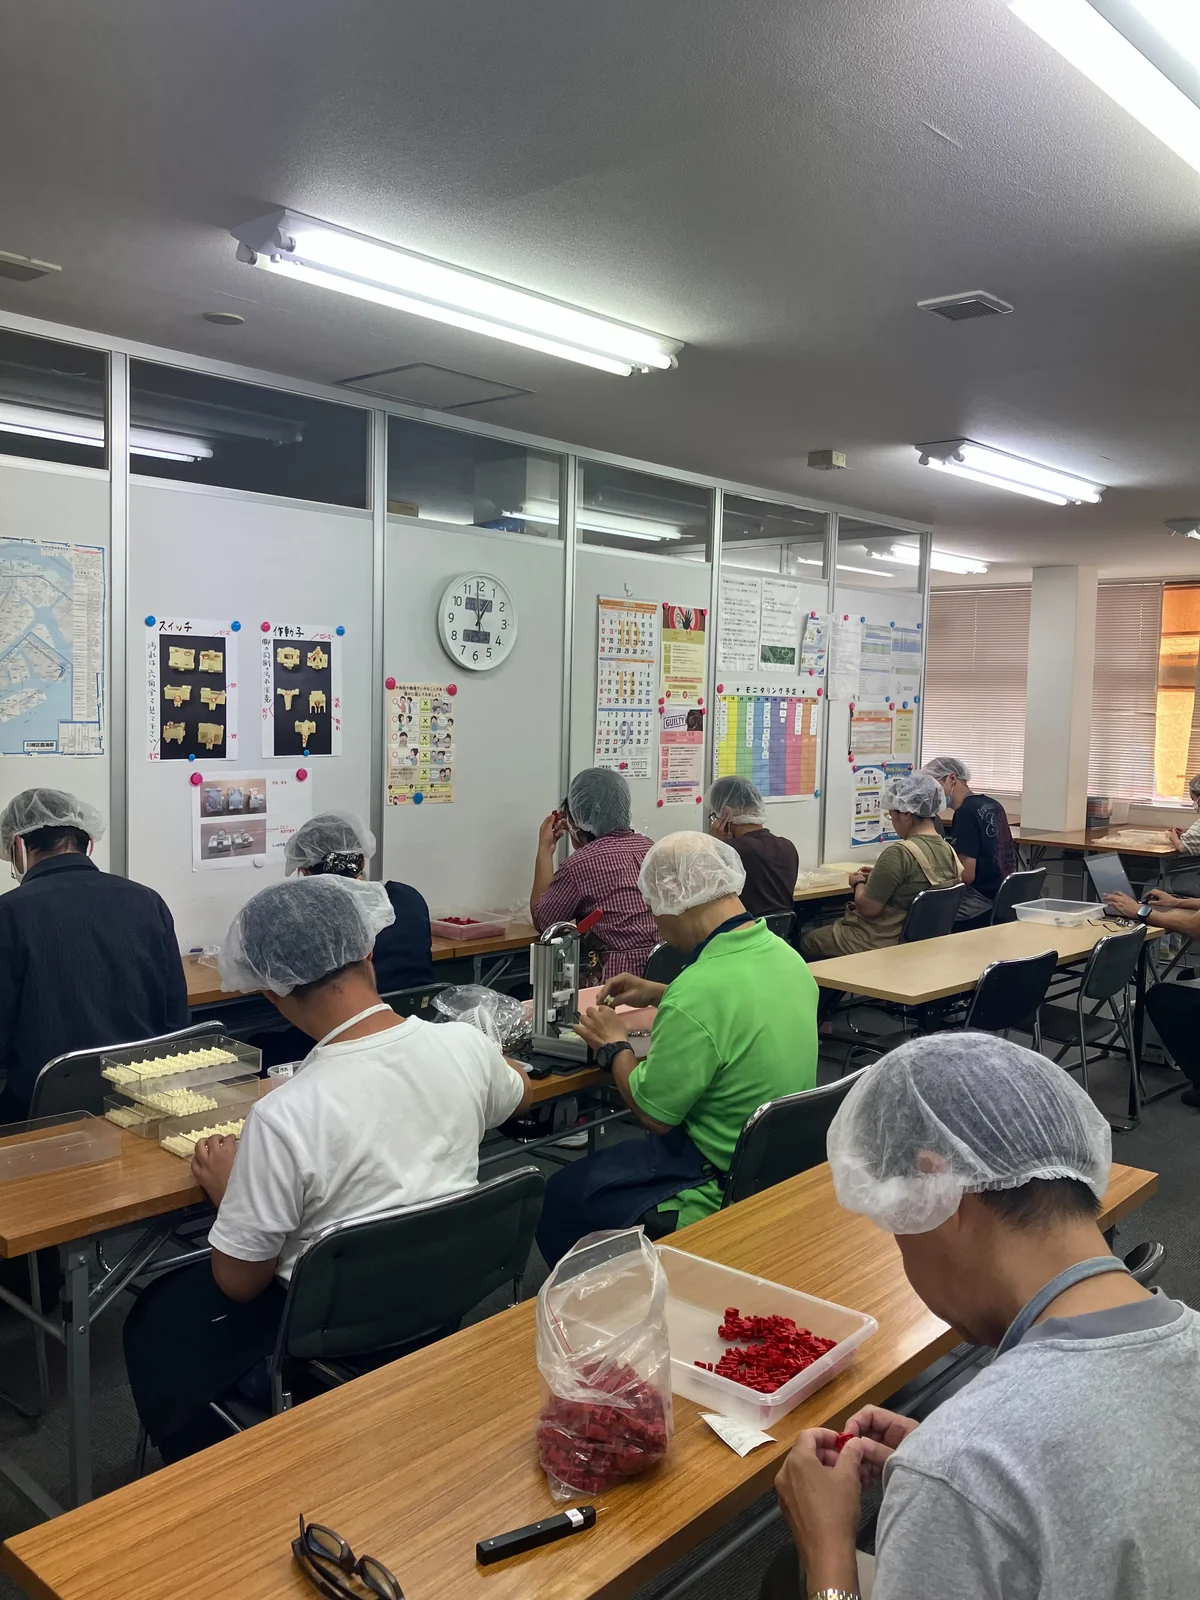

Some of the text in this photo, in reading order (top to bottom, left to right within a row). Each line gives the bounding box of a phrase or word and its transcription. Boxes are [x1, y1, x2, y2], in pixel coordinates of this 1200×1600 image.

[463, 583, 471, 595] 11
[492, 588, 496, 598] 1
[453, 595, 462, 607] 10
[499, 602, 505, 612] 2
[448, 612, 455, 623] 9
[159, 621, 192, 632] スイッチ
[501, 619, 507, 630] 3
[273, 626, 304, 638] 作動子
[451, 630, 457, 640] 8
[495, 636, 501, 646] 4
[460, 645, 466, 655] 7
[472, 650, 478, 661] 6
[486, 647, 492, 657] 5
[746, 687, 796, 695] モニタリング予定
[665, 716, 685, 727] GUILTY
